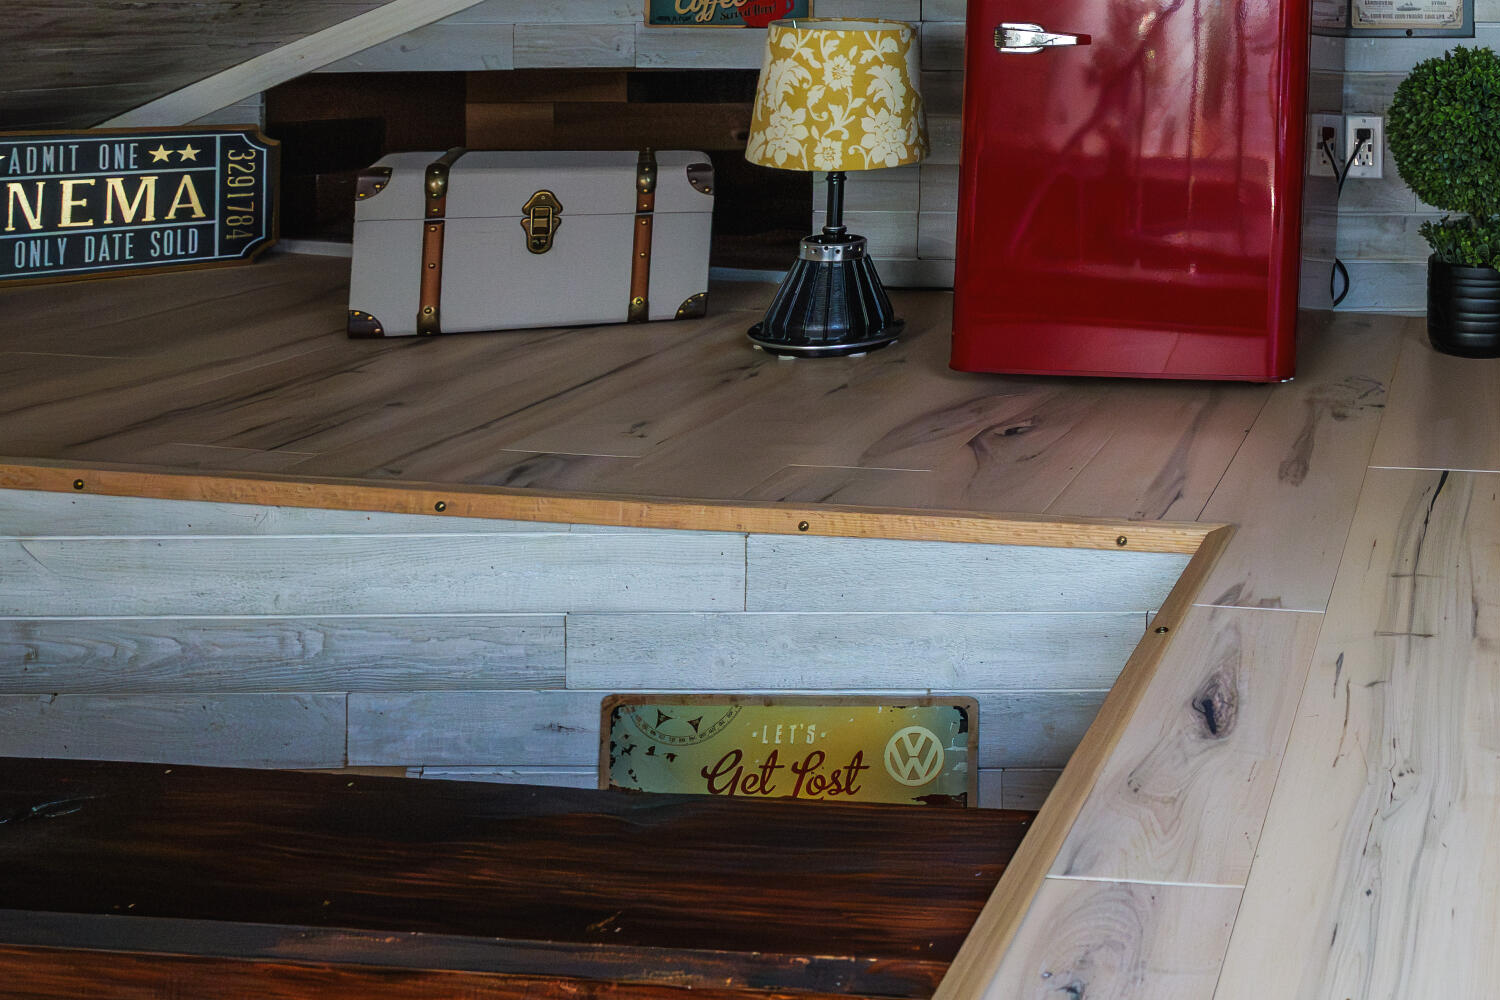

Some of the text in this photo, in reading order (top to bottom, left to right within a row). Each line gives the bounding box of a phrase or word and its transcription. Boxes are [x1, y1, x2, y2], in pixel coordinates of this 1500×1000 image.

[8, 142, 139, 175] ADMIT ONE
[4, 174, 207, 232] NEMA
[225, 148, 257, 240] 3291784
[14, 227, 199, 270] ONLY DATE SOLD
[762, 723, 818, 745] LET'S
[883, 725, 945, 787] VW
[700, 748, 870, 799] Get Lost
